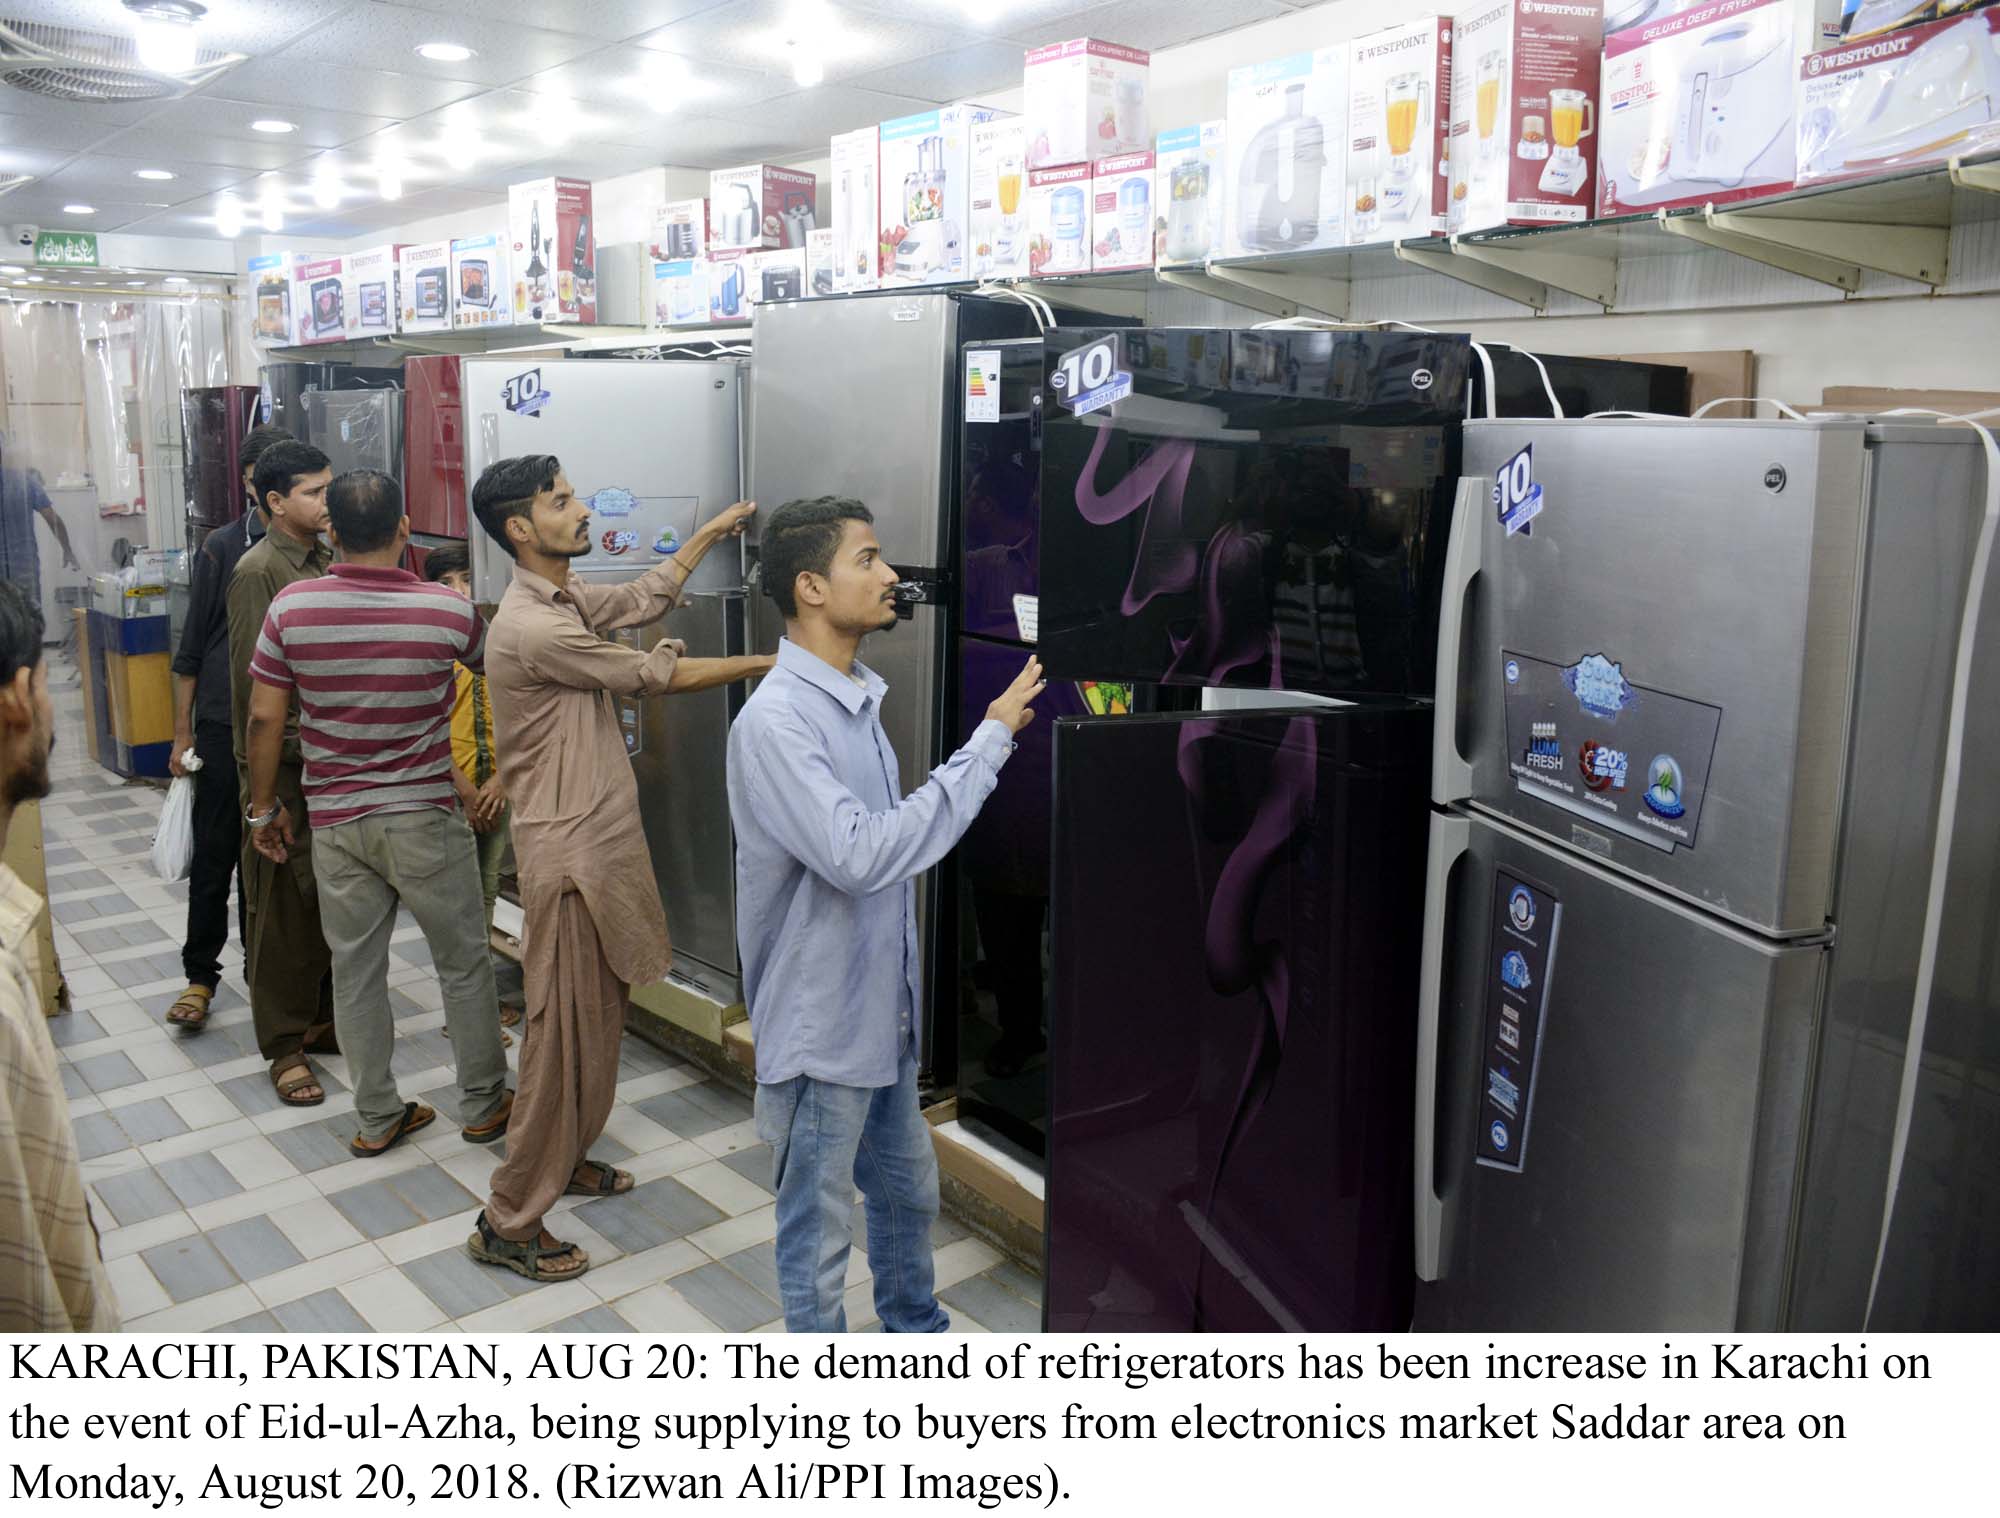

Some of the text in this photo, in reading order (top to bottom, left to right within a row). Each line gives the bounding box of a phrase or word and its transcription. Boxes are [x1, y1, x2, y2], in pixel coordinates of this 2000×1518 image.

[1464, 4, 1509, 35] WESTPOINT
[1533, 2, 1599, 17] WESTPOINT
[1642, 19, 1684, 41] DELUXE
[1686, 9, 1717, 25] DEEP
[1367, 32, 1429, 59] WESTPOINT
[1822, 35, 1913, 69] WESTPOINT
[1610, 80, 1656, 104] WESTPOI
[1043, 168, 1086, 181] WESTPOINT
[1105, 157, 1148, 169] WESTPOINT
[772, 171, 814, 185] WESTPOINT
[1062, 344, 1113, 398] 10
[507, 372, 539, 406] 10
[1081, 386, 1126, 413] WARRANTY
[1498, 452, 1531, 514] 10
[1526, 752, 1563, 770] FRESH
[1595, 746, 1628, 770] 20%
